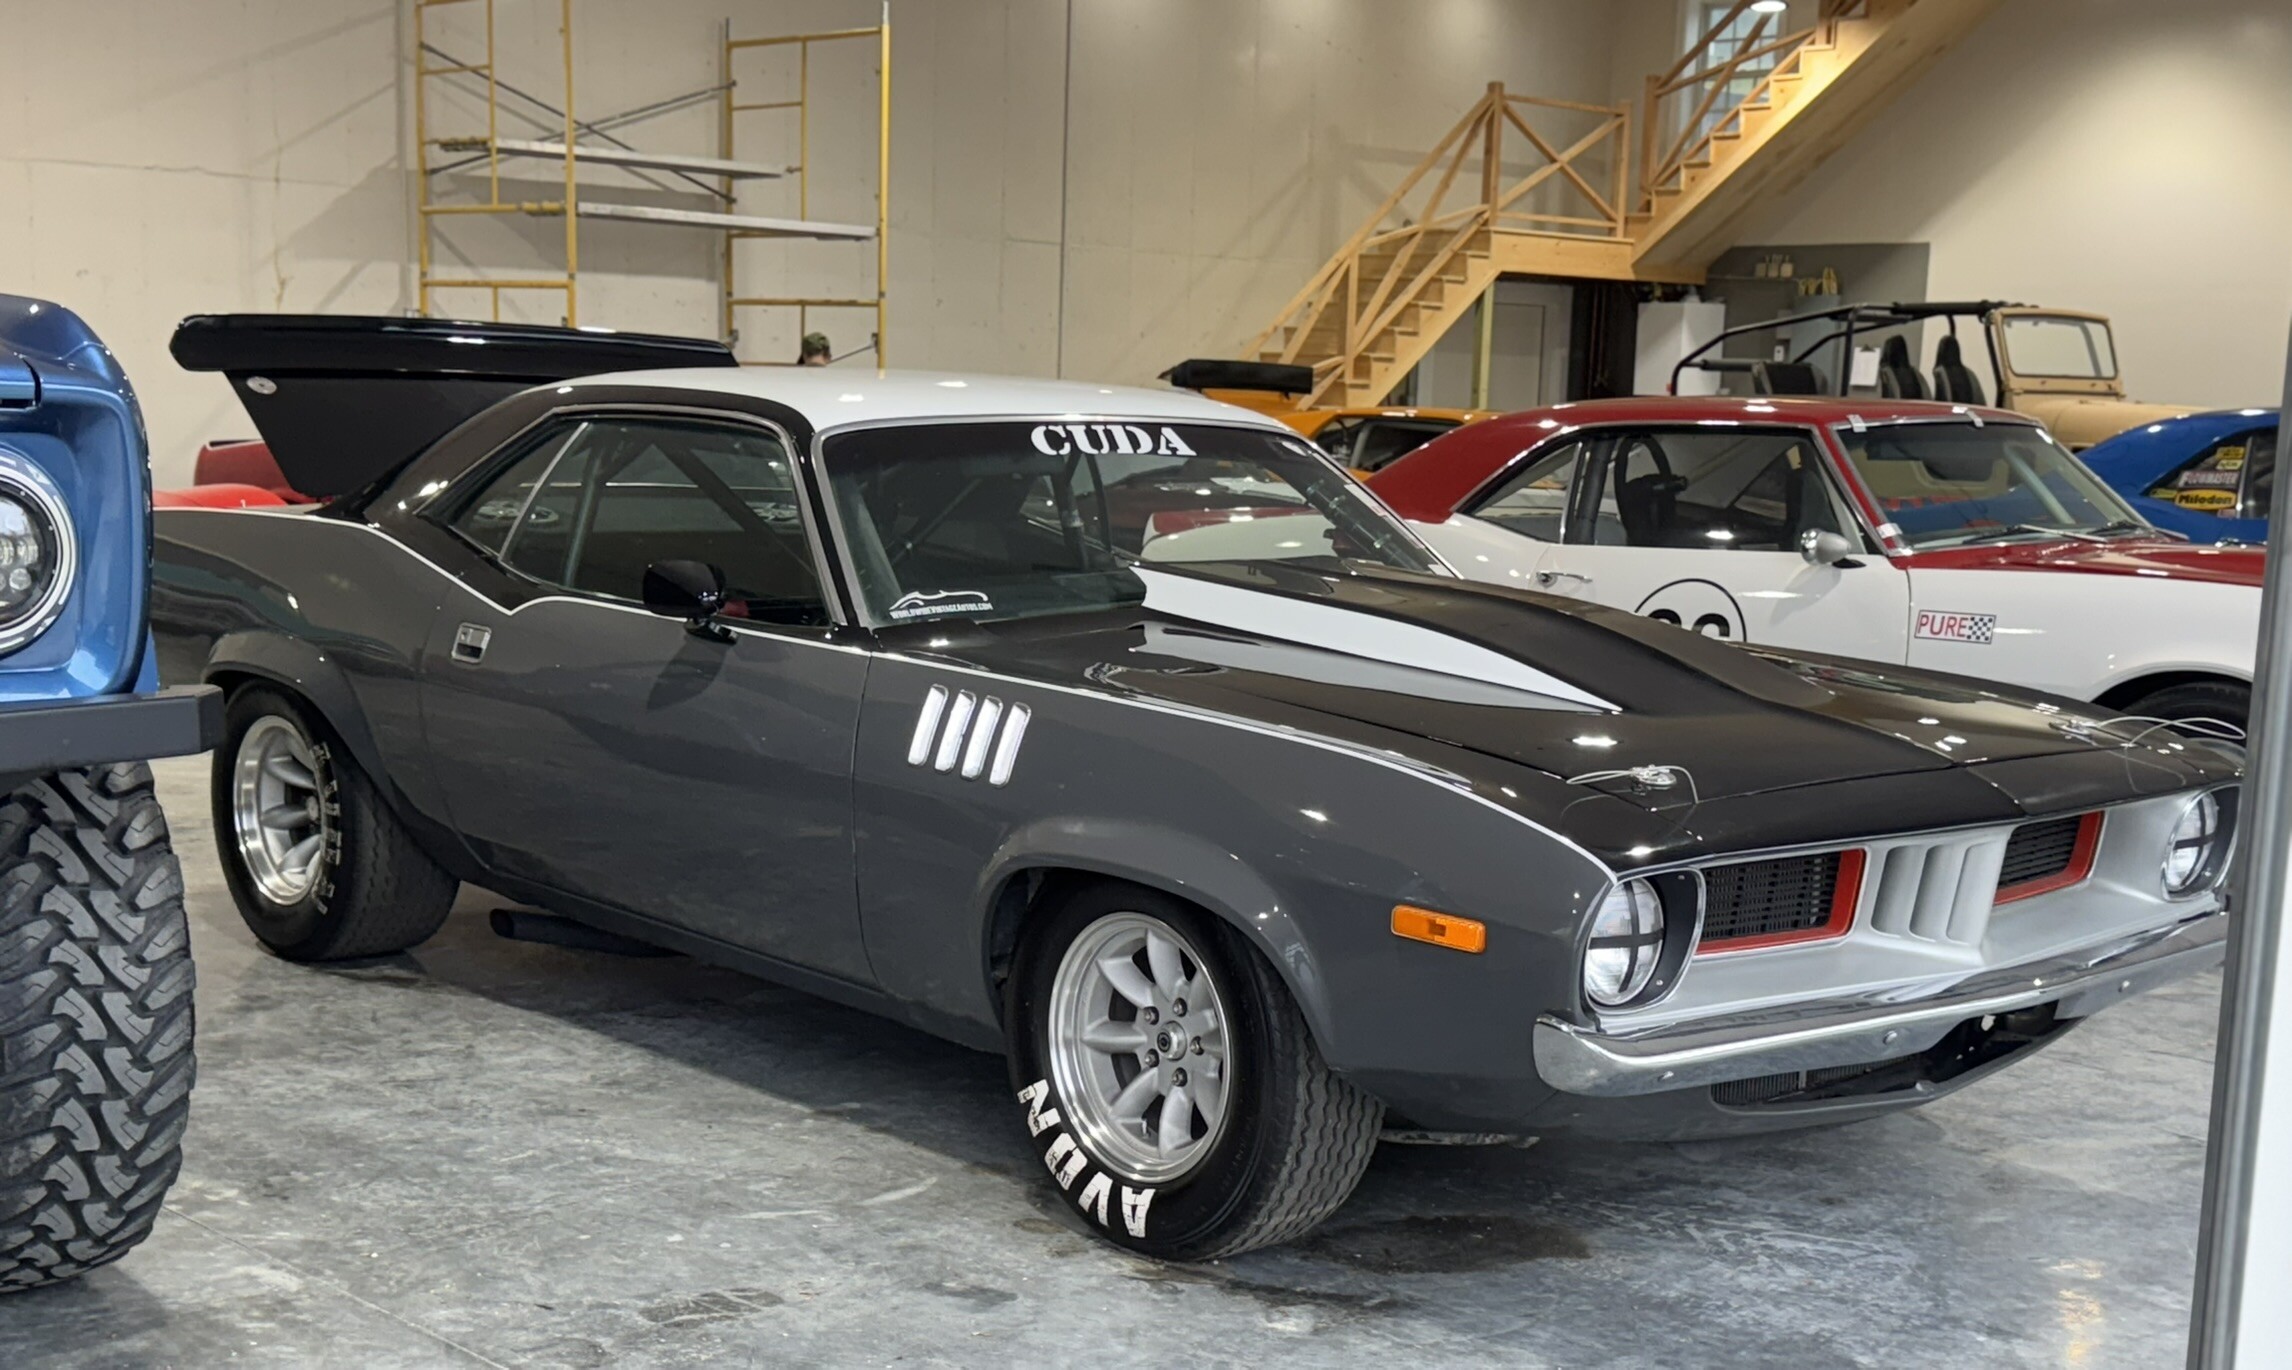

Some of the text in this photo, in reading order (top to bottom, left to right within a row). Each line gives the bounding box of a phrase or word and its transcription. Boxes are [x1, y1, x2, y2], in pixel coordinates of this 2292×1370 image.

[1031, 424, 1197, 456] CUDA
[1917, 614, 1969, 637] PURE
[1017, 1079, 1156, 1238] AVON
